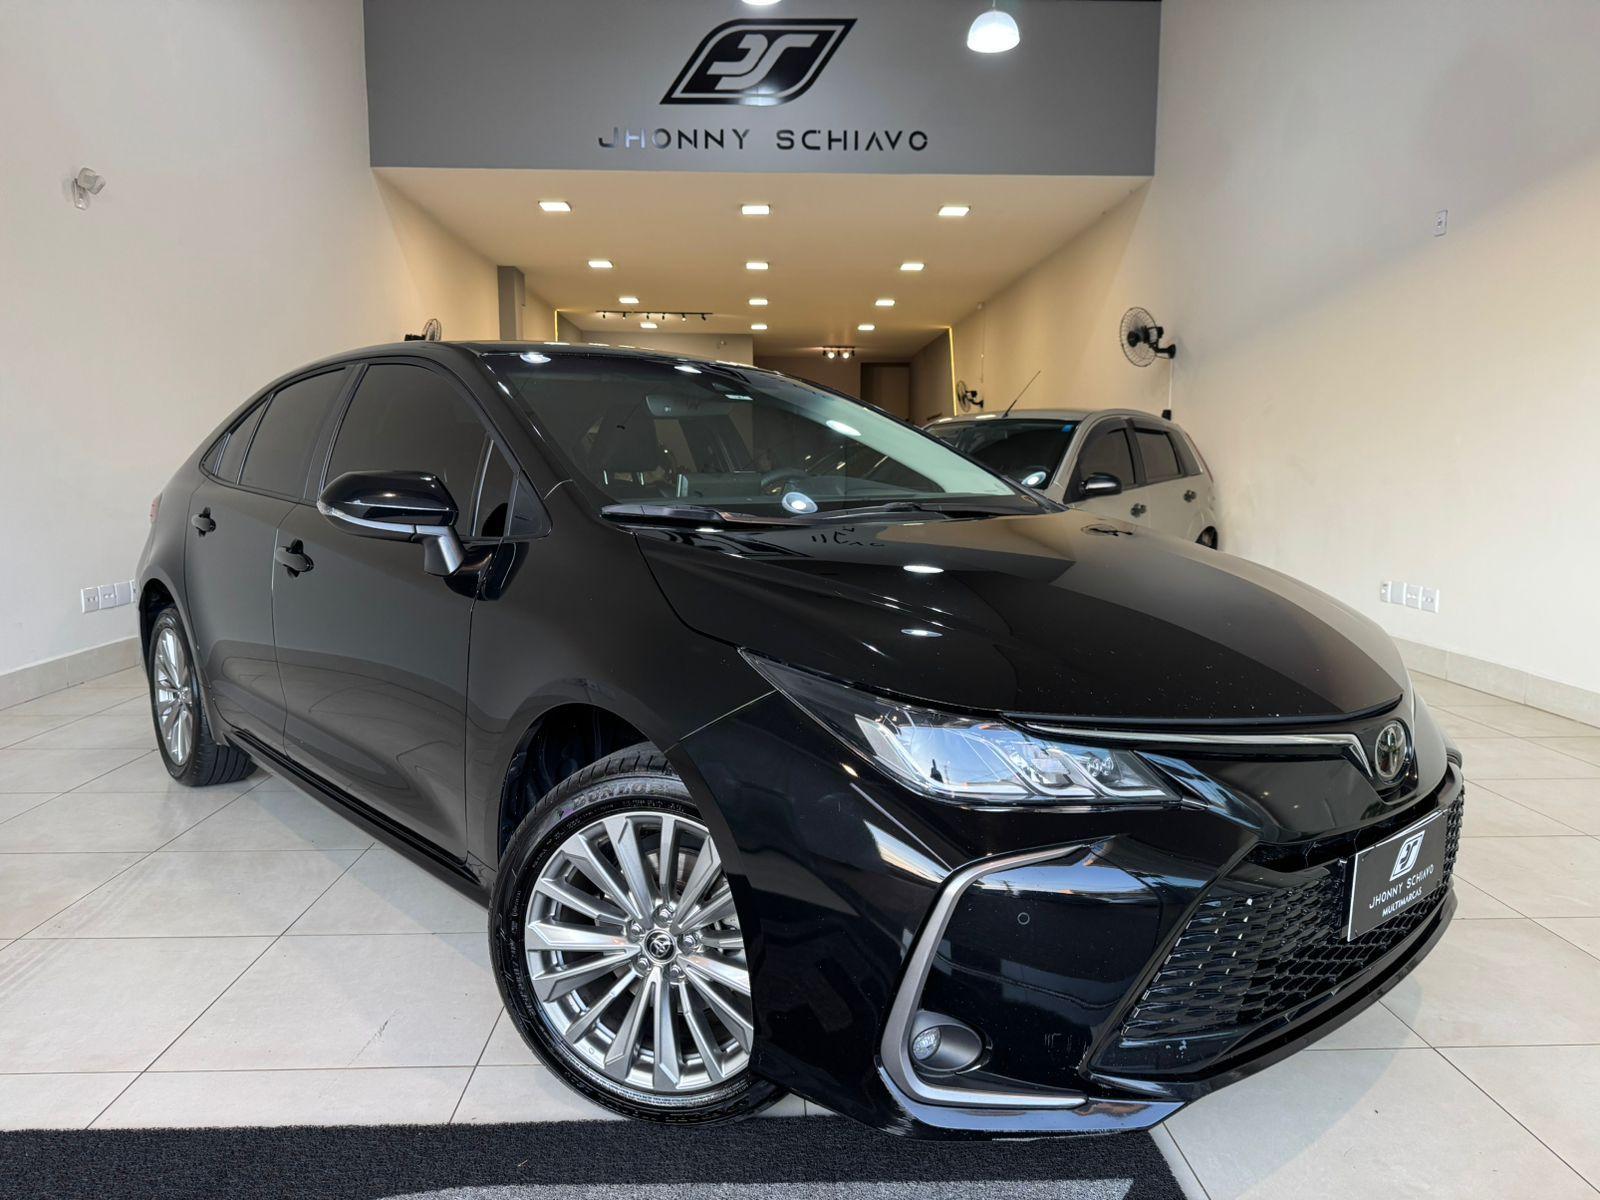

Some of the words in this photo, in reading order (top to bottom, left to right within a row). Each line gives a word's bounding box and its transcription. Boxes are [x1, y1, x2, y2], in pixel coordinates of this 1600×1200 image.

[598, 126, 750, 150] JHONNY
[776, 129, 929, 152] SCHIAVO
[1369, 881, 1404, 909] JHONNY
[1406, 864, 1435, 889] SCHIAVO
[1381, 886, 1423, 918] MULTIMARCAS
